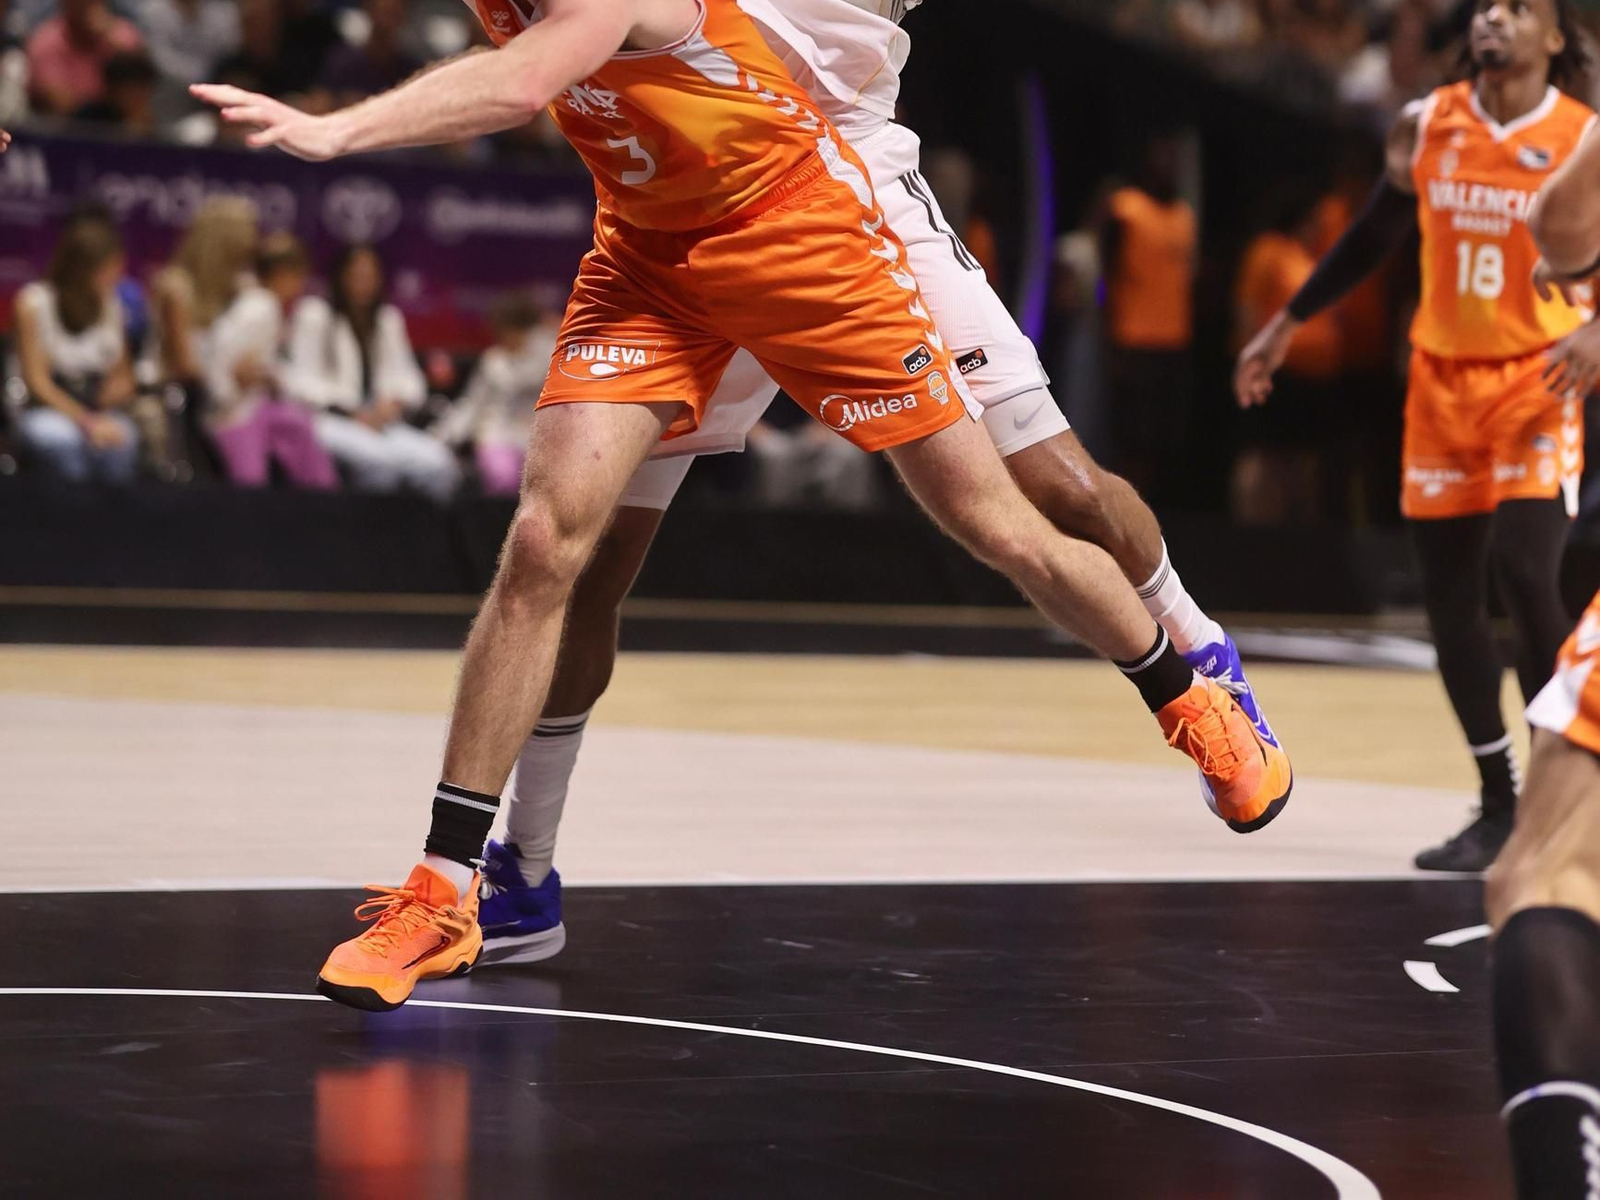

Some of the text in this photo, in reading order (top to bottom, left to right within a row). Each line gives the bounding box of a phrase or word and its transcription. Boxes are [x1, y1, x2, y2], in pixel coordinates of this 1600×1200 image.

[606, 136, 656, 185] 3
[1456, 240, 1505, 300] 18
[565, 343, 647, 366] PULEVA
[908, 354, 927, 373] acb
[960, 356, 982, 374] acb
[837, 393, 918, 427] Midea
